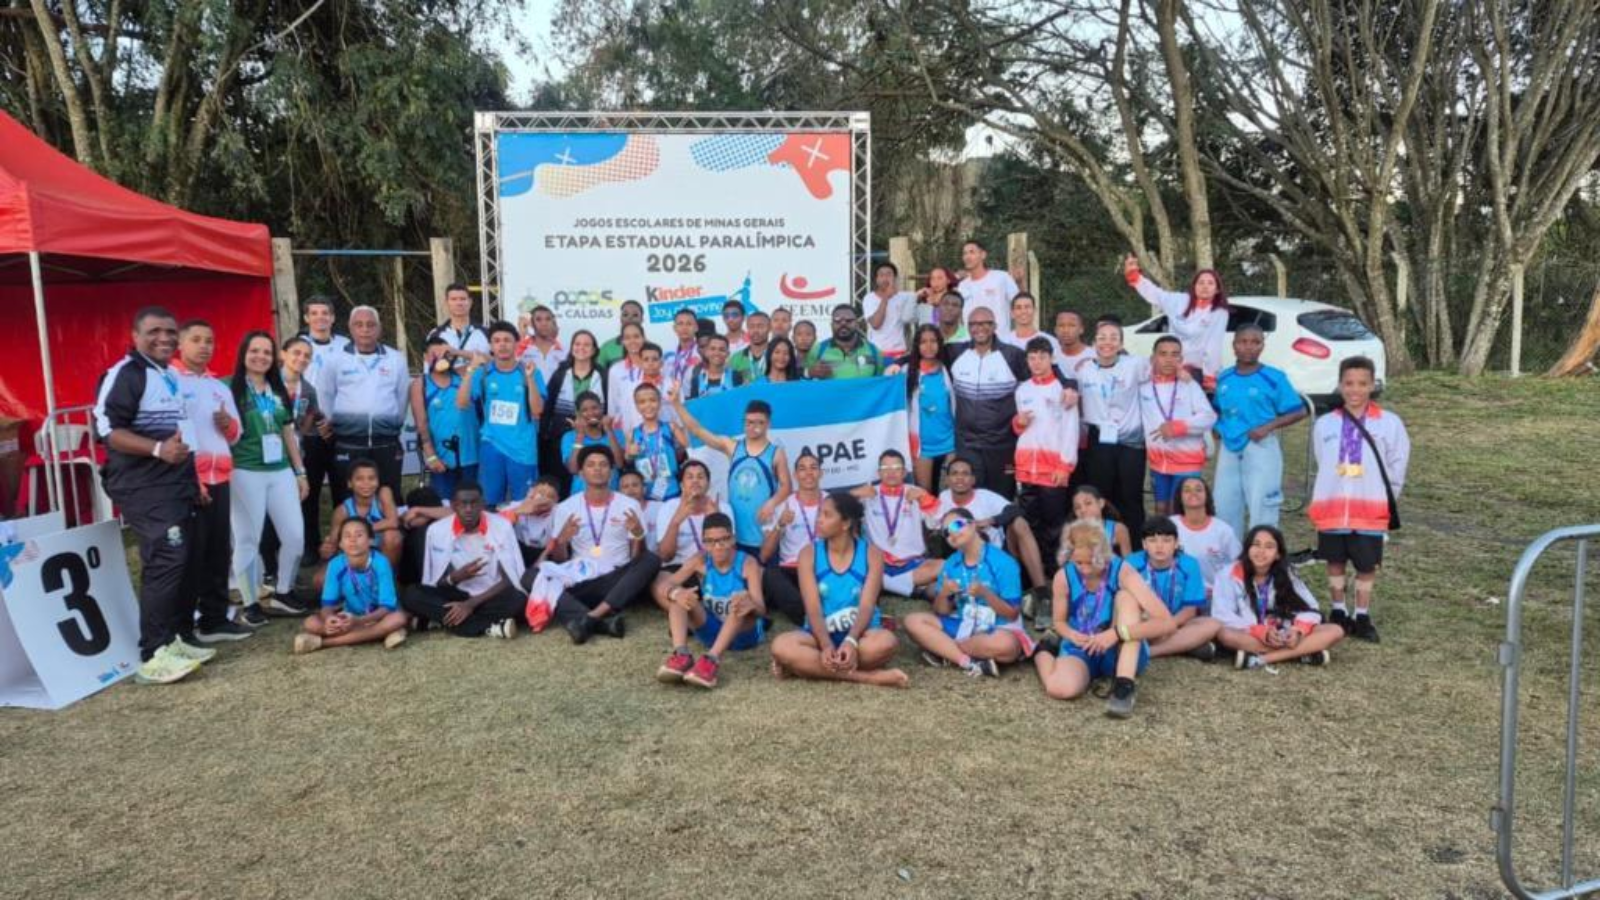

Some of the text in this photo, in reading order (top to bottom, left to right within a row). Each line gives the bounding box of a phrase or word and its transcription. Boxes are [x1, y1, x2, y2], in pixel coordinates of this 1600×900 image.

[573, 218, 785, 228] JOGOS ESCOLARES DE MINAS GERAIS
[544, 232, 816, 249] ETAPA ESTADUAL PARALÍMPICA
[646, 254, 706, 273] 2026
[565, 308, 613, 319] CALDAS
